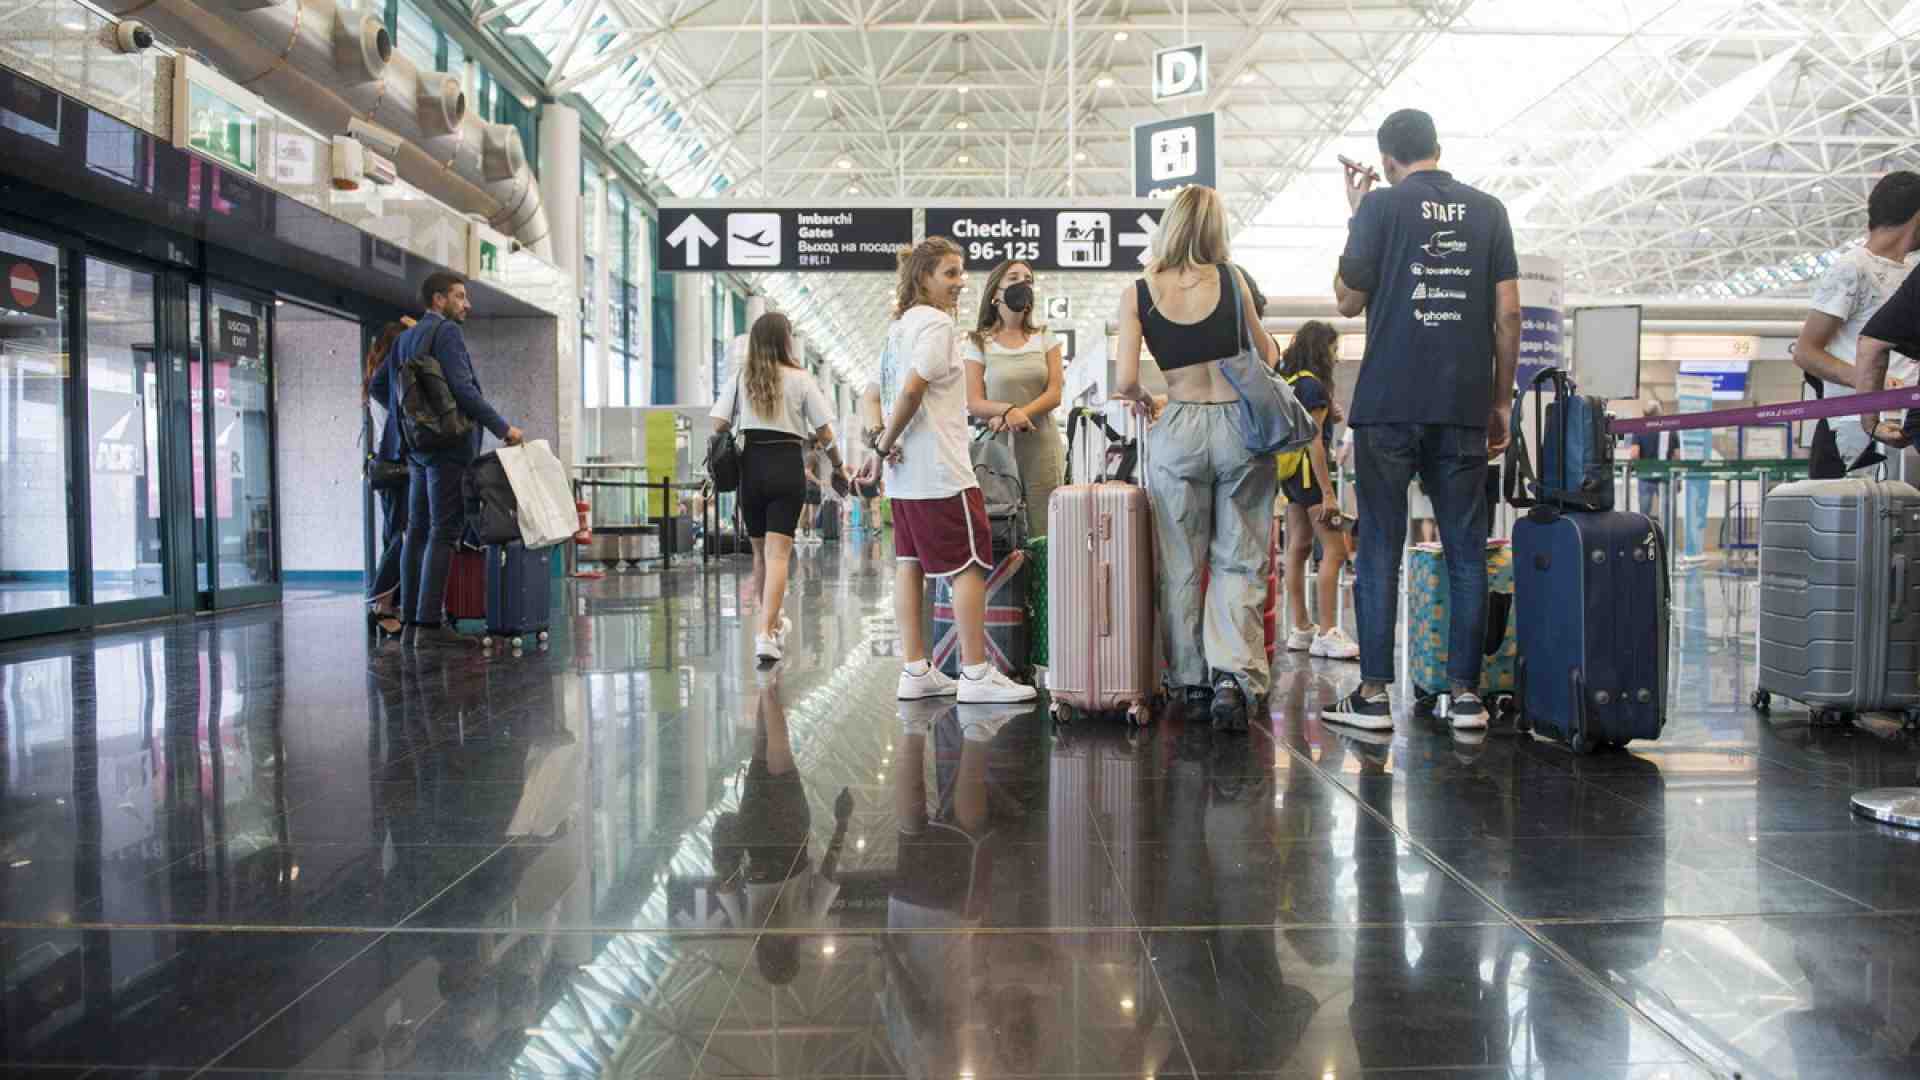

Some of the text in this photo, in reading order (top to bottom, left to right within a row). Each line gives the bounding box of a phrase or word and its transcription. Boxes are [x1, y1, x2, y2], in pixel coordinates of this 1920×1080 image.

[1161, 50, 1198, 96] D
[798, 212, 852, 225] Imbarchi
[1421, 200, 1466, 222] STAFF
[798, 226, 834, 239] Gates
[952, 218, 1040, 238] Check-in
[798, 240, 839, 254] Выход
[841, 242, 857, 253] на
[969, 241, 1040, 261] 96-125
[1051, 299, 1066, 319] C
